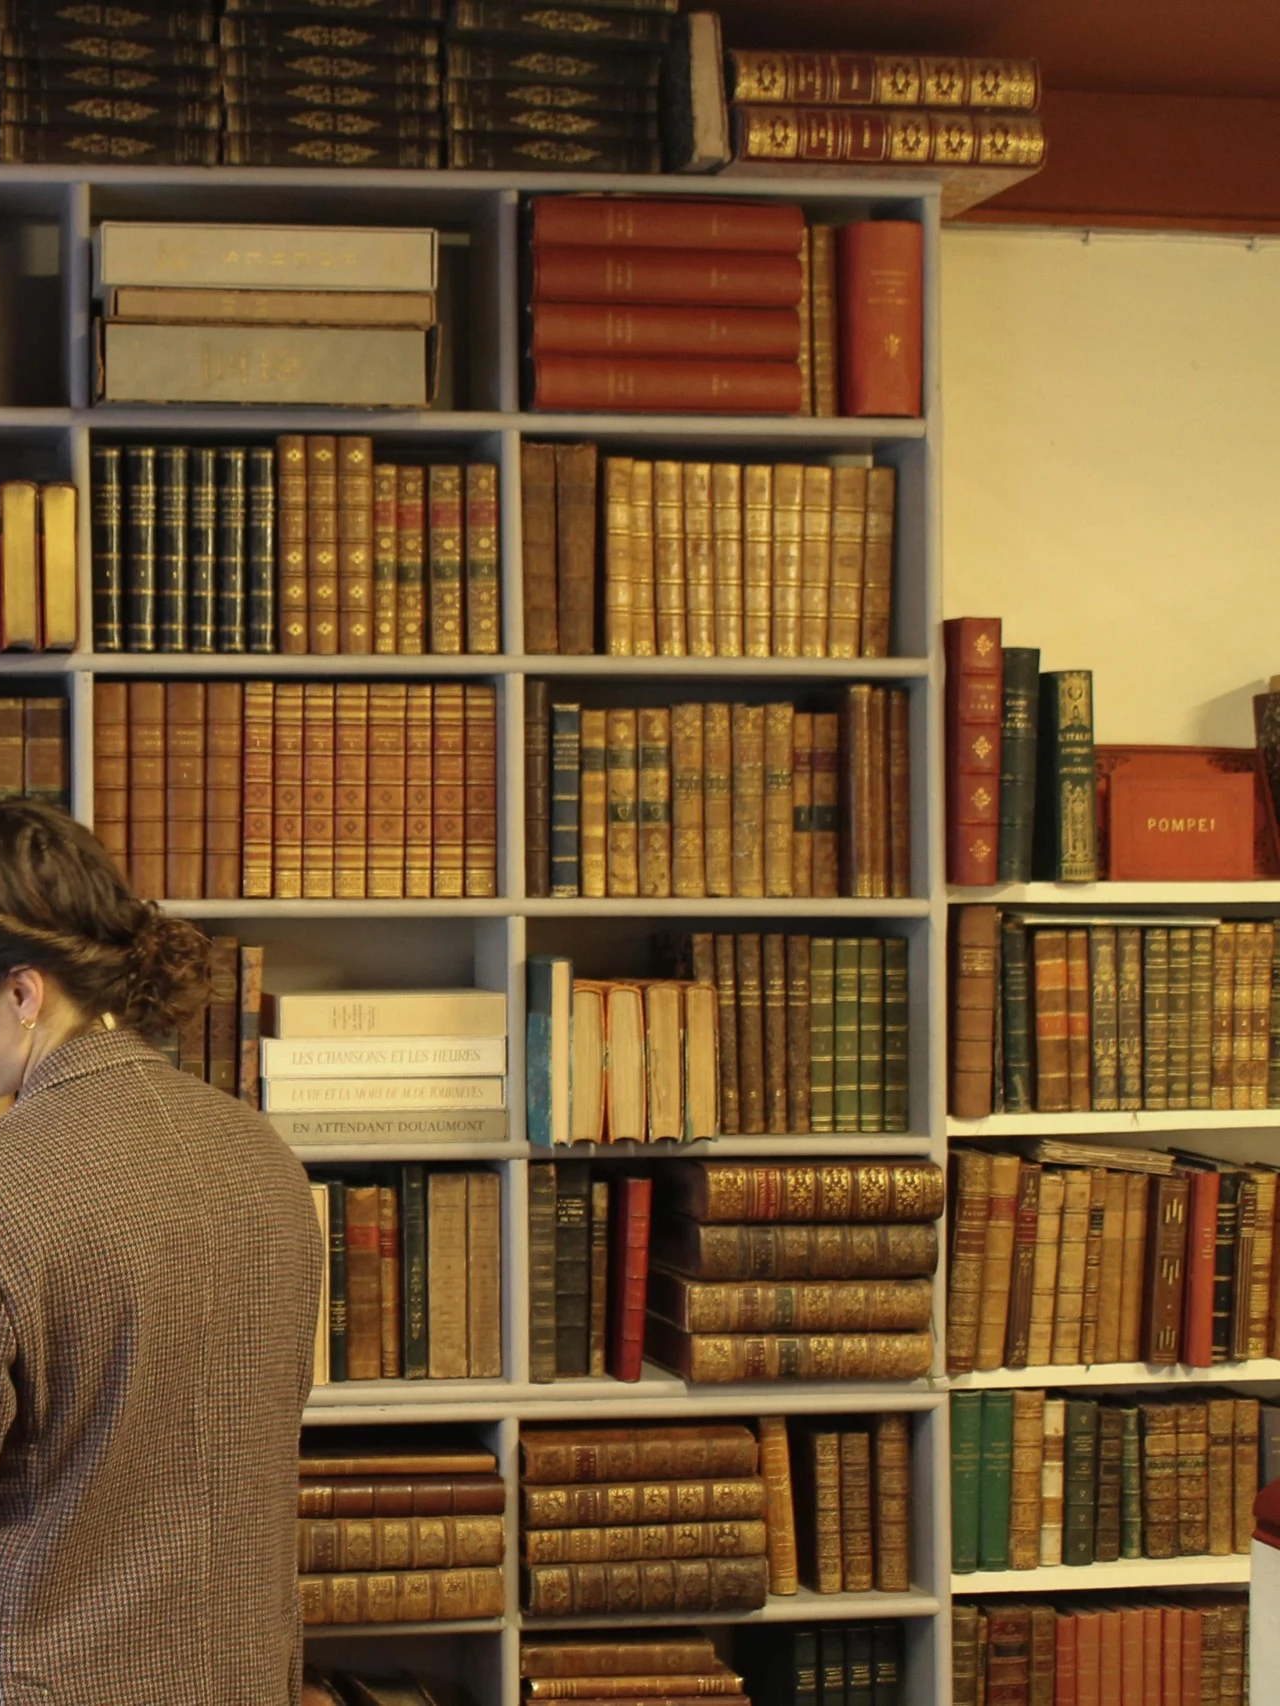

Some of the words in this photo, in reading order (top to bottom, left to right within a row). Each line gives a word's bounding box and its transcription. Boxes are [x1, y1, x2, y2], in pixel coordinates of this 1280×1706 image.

[1147, 817, 1216, 832] POMPEI
[292, 1051, 314, 1066] LES
[318, 1050, 386, 1065] CHANSONS
[390, 1050, 407, 1064] ET
[408, 1050, 429, 1063] LES
[432, 1049, 481, 1063] HEURES
[292, 1122, 310, 1133] EN
[314, 1121, 393, 1133] ATTENDANT
[398, 1120, 486, 1132] DOUAUMONT
